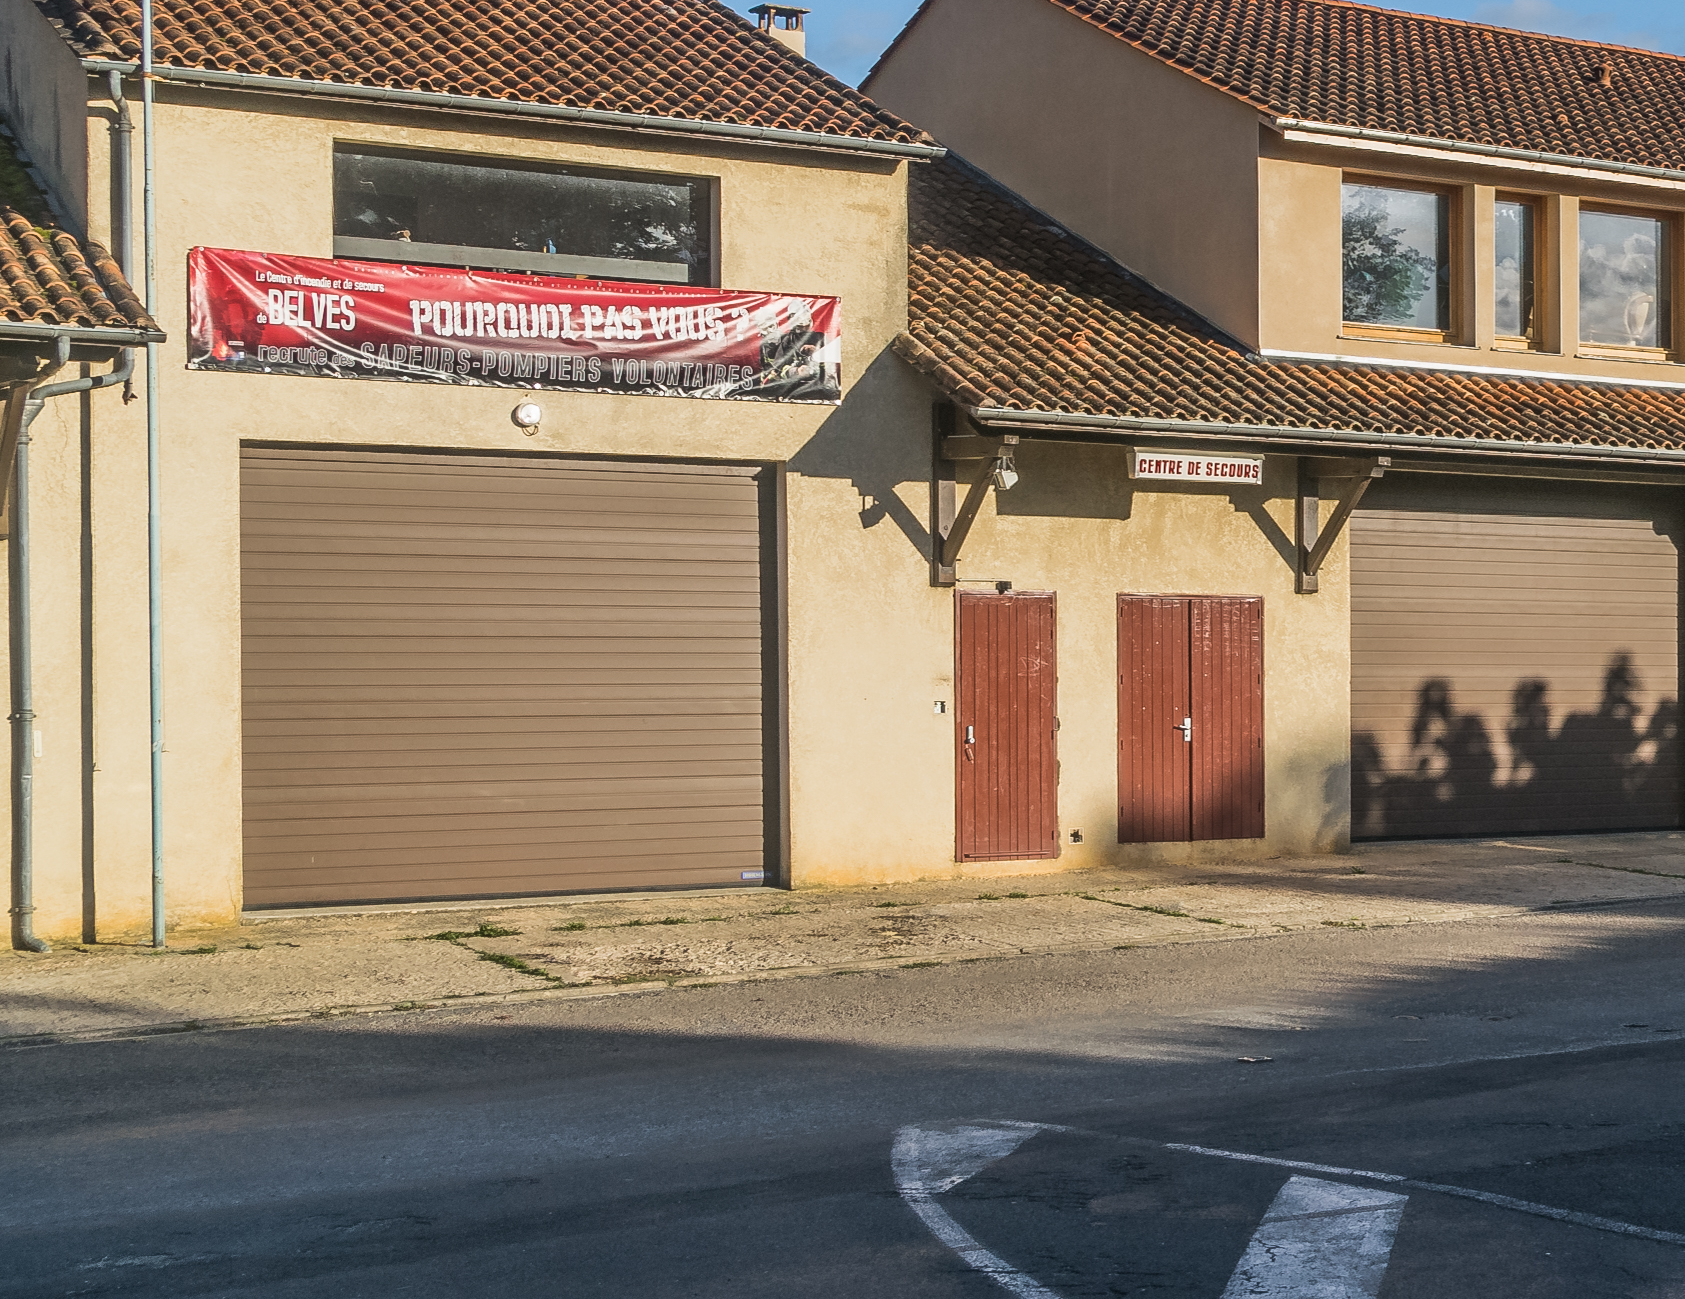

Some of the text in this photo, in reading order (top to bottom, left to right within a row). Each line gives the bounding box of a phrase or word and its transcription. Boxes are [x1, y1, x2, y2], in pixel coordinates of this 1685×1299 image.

[256, 270, 385, 293] Le Centre d'incendie et de secours
[256, 288, 356, 331] de BELVES
[409, 299, 750, 341] POURQUOI PAS VOUS ?
[257, 342, 754, 390] recrute des SAPEURS-POMPIERS VOLONTAIRES
[1139, 458, 1259, 478] CENTRE DE SECOURS
